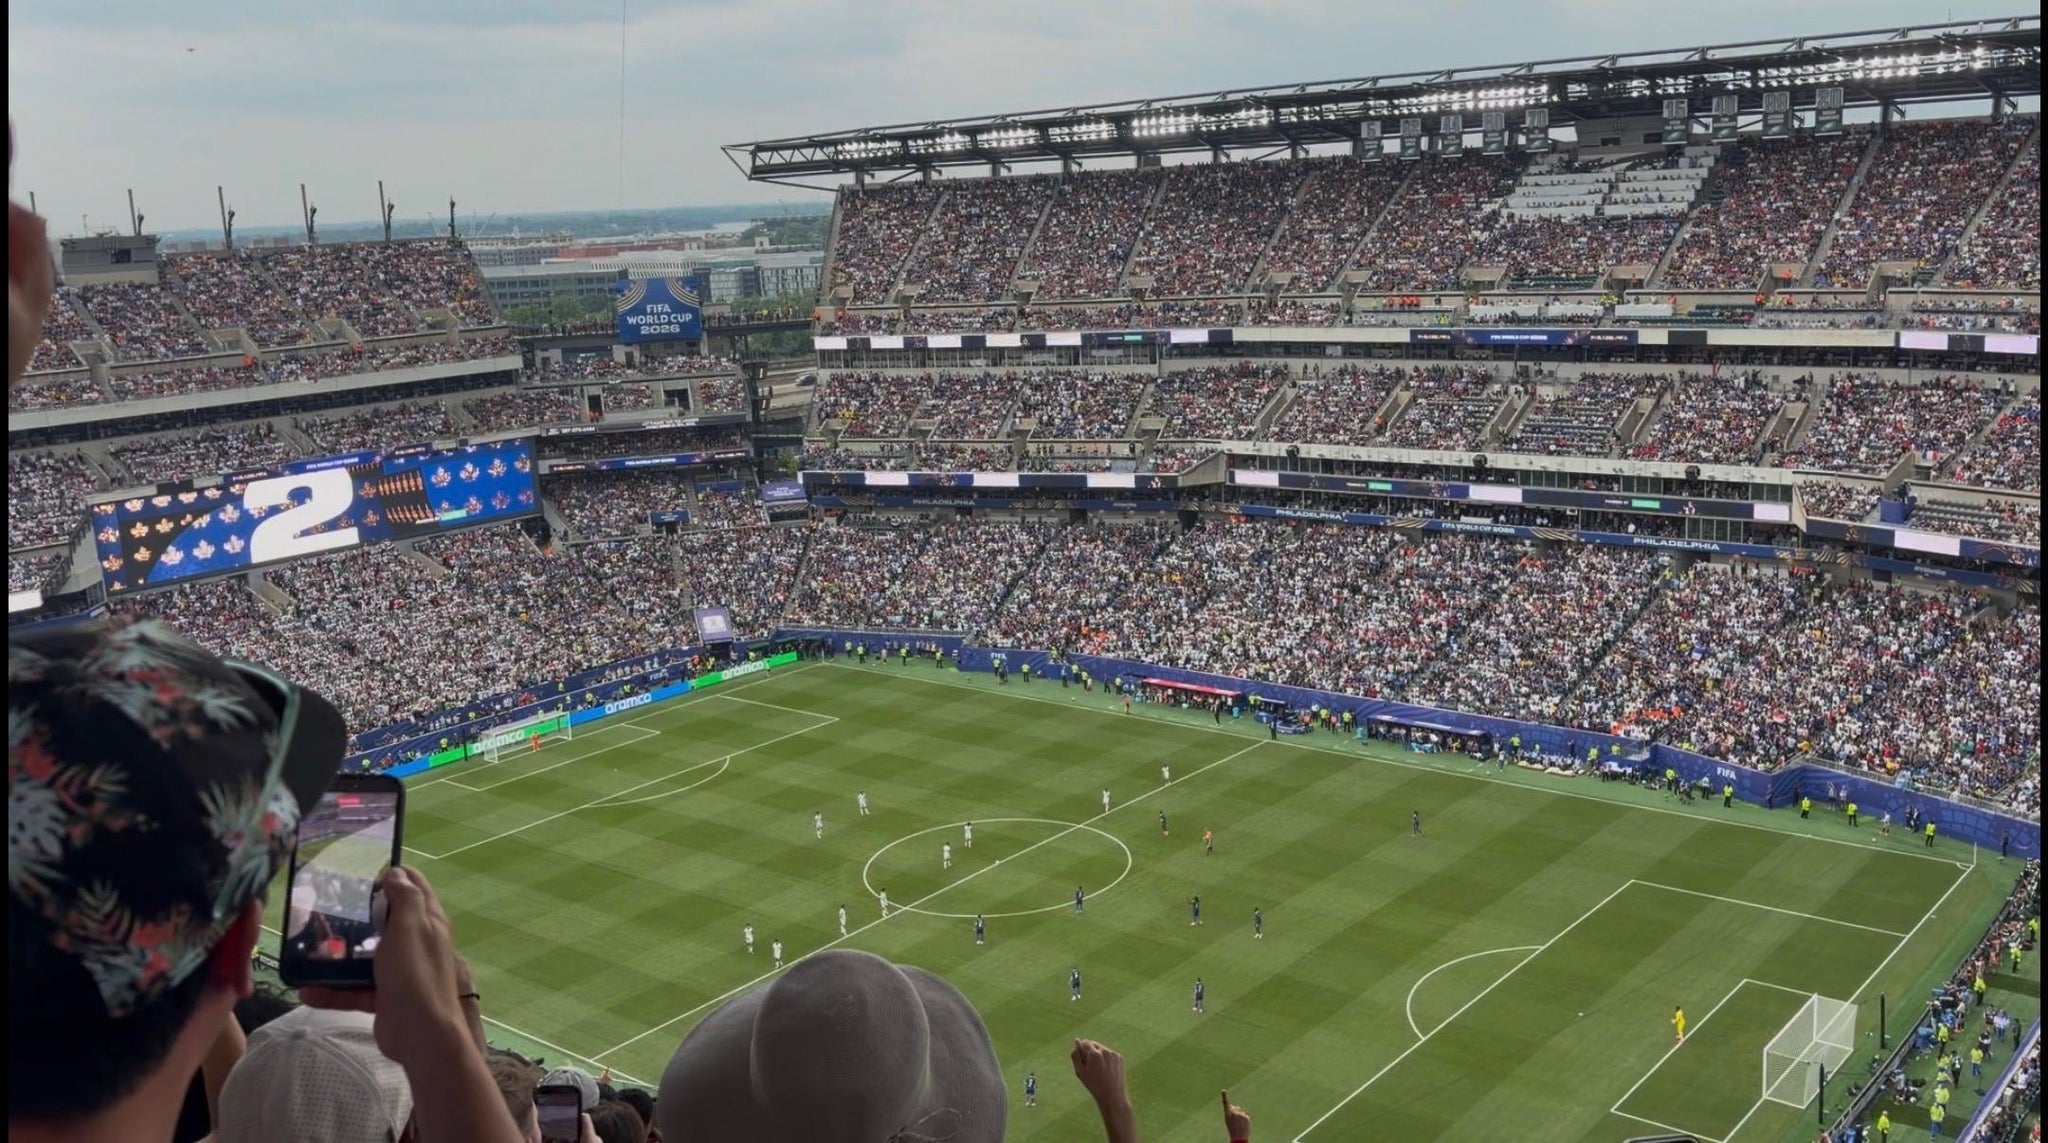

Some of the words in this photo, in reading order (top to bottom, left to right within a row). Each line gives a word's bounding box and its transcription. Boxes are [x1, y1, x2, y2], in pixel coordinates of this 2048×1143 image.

[646, 303, 672, 314] FIFA
[626, 314, 669, 325] WORLD
[670, 313, 692, 324] CUP
[640, 324, 681, 335] 2026
[912, 498, 976, 506] PHILADELPHIA
[243, 467, 360, 564] 2
[1275, 509, 1342, 520] PHILADELPHIA
[1456, 523, 1479, 532] WORLD
[1633, 537, 1720, 551] PHILADELPHIA
[722, 660, 764, 680] aramco
[605, 692, 652, 714] aramco
[472, 729, 525, 754] aramco
[1716, 766, 1736, 780] FIFA
